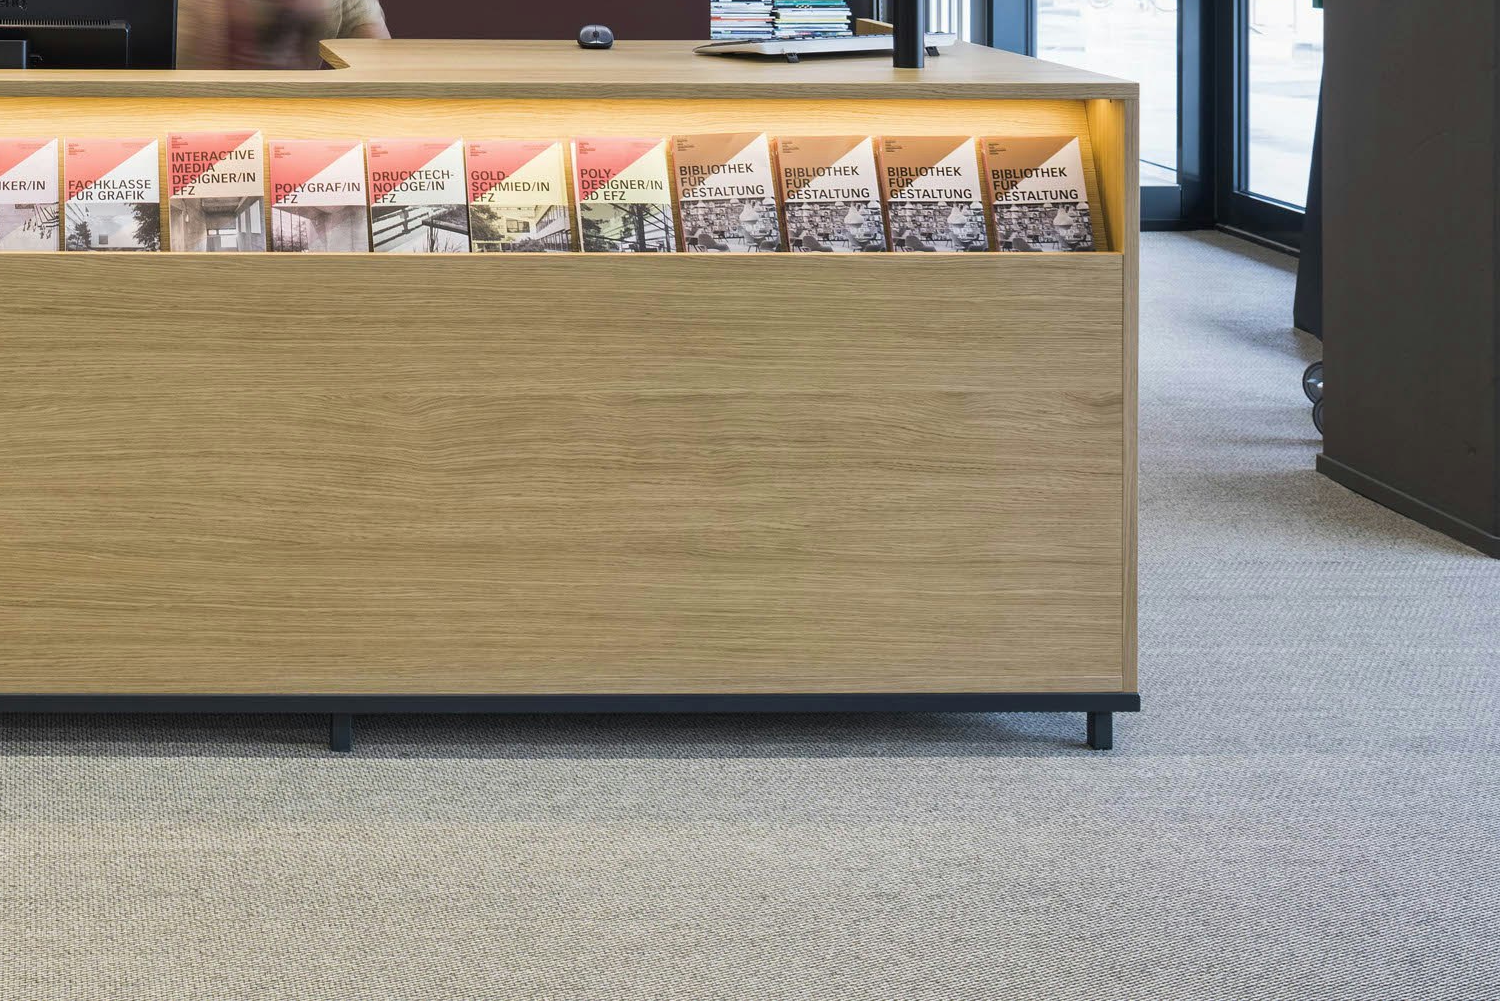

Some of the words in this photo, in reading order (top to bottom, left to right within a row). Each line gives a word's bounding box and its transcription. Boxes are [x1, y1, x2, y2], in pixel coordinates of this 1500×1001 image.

[172, 150, 255, 162] INTERACTIVE
[172, 163, 215, 173] MEDIA
[680, 163, 754, 176] BIBLIOTHEK
[784, 166, 859, 178] BIBLIOTHEK
[887, 167, 961, 177] BIBLIOTHEK
[992, 167, 1067, 179] BIBLIOTHEK
[172, 172, 256, 184] DESIGNER/IN
[372, 169, 454, 182] DRUCKTECH-
[471, 171, 509, 181] GOLD-
[581, 169, 616, 179] POLY-
[68, 180, 151, 190] FACHKLASSE
[581, 180, 663, 190] DESIGNER/IN
[681, 176, 705, 186] FÜR
[786, 178, 810, 188] FÜR
[889, 177, 913, 187] FÜR
[993, 179, 1018, 190] FÜR
[173, 186, 195, 196] EFZ
[275, 182, 361, 193] POLYGRAF/IN
[373, 181, 445, 192] NOLOGE/IN
[471, 182, 550, 192] SCHMIED/IN
[682, 185, 765, 198] GESTALTUNG
[68, 190, 93, 200] FÜR
[98, 191, 144, 200] GRAFIK
[472, 193, 495, 202] EFZ
[582, 191, 599, 201] 3D
[604, 191, 626, 201] EFZ
[787, 188, 870, 199] GESTALTUNG
[890, 188, 972, 198] GESTALTUNG
[995, 189, 1078, 202] GESTALTUNG
[276, 194, 298, 204] EFZ
[374, 194, 396, 203] EFZ
